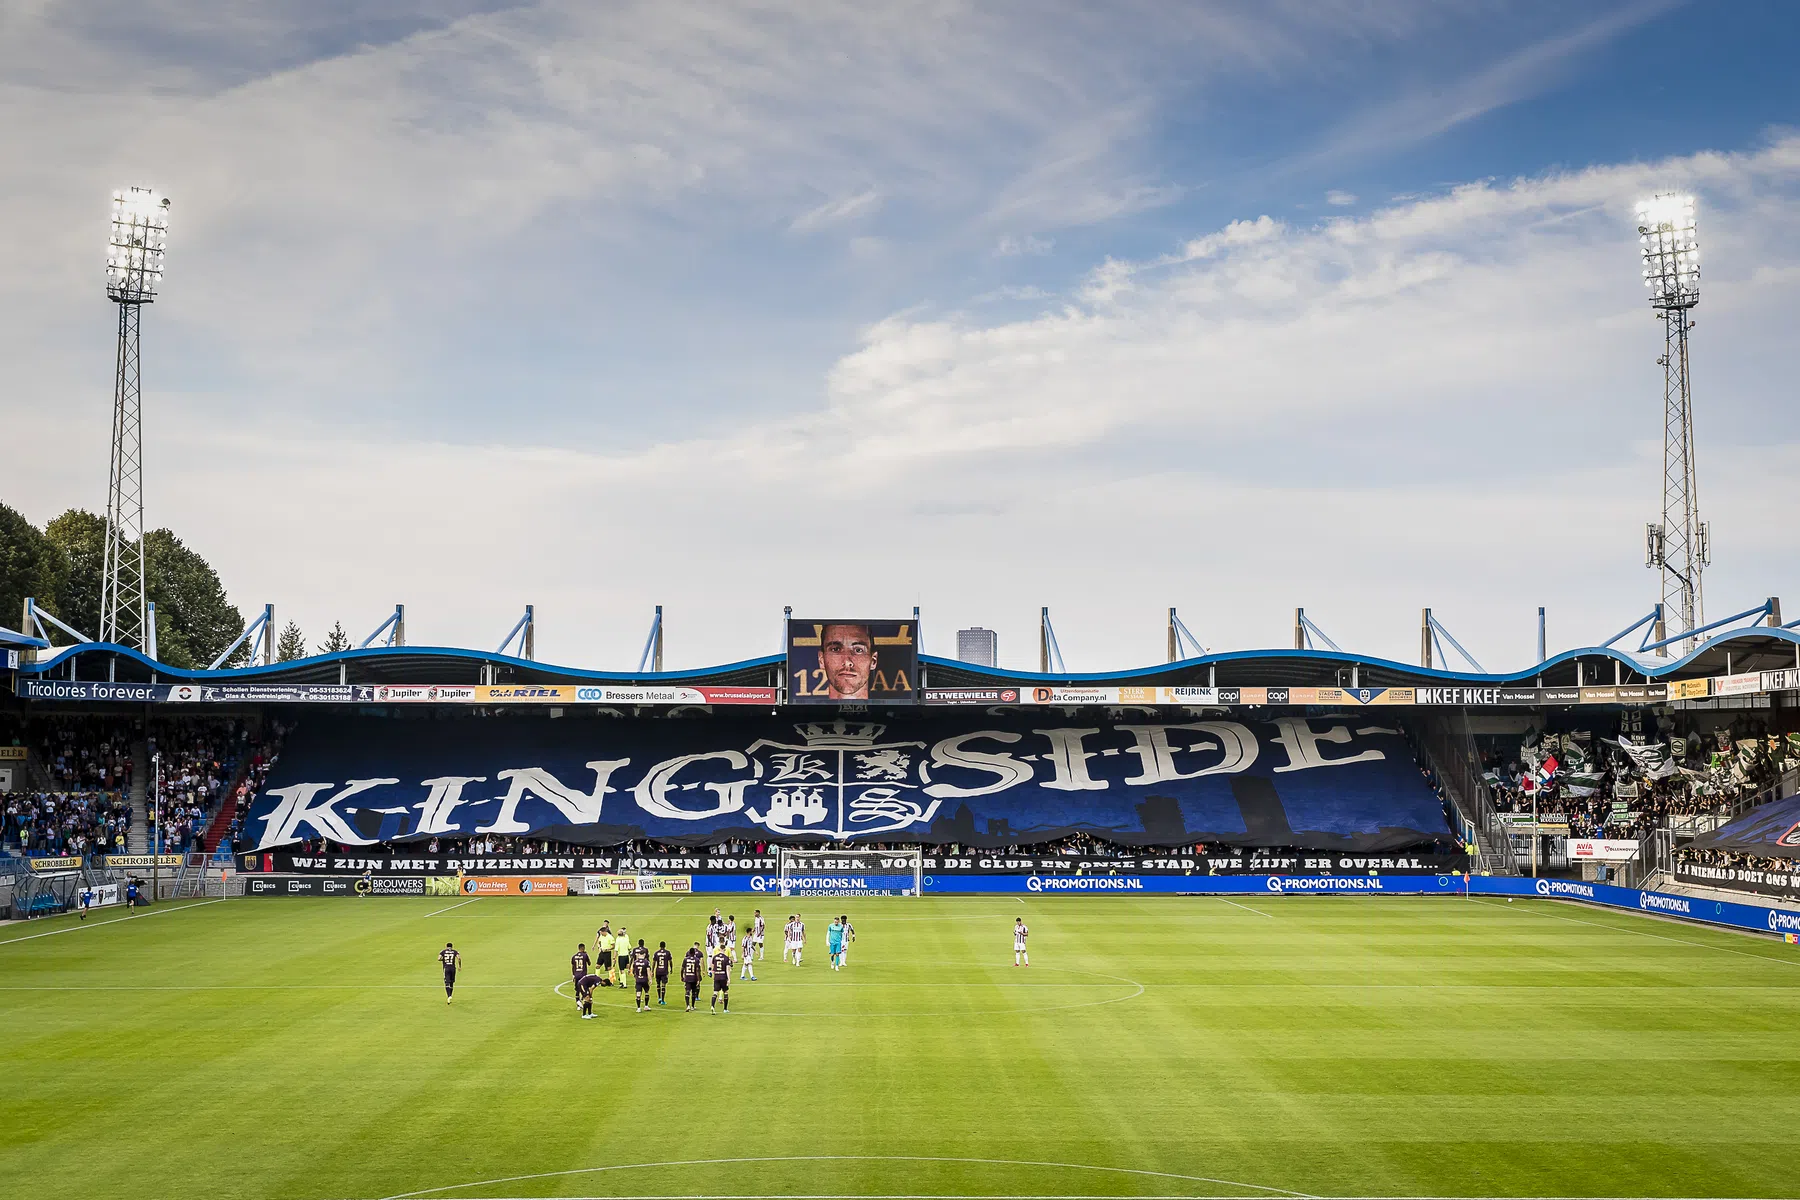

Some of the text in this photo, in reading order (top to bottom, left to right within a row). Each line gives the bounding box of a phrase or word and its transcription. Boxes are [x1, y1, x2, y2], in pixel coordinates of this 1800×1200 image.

[27, 682, 156, 699] Tricolores forever.
[794, 669, 830, 696] 12
[390, 689, 422, 698] Jupiler
[440, 689, 471, 698] Jupiler
[606, 691, 674, 700] Bressers Metaal
[922, 716, 1386, 798] SIDE
[292, 857, 327, 868] WE
[334, 858, 383, 869] ZIJN
[390, 860, 439, 870] MET
[447, 859, 574, 870] DUIZENDEN
[582, 858, 612, 868] EN
[708, 859, 776, 868] NOOIT
[881, 859, 936, 868] VOOR
[944, 859, 972, 868] DE
[979, 859, 1034, 868] CLUB
[1208, 859, 1242, 868] WE
[1305, 859, 1332, 868] ER
[750, 876, 868, 892] Q-PROMOTIONS.NL
[1026, 876, 1143, 892] Q-PROMOTIONS.NL
[1266, 876, 1383, 892] Q-PROMOTIONS.NL
[1737, 870, 1763, 883] DOET
[1766, 874, 1788, 887] ONS
[1536, 879, 1594, 897] Q-PROMOTIONS.NL
[1640, 892, 1690, 912] Q-PROMOTIONS.NL
[574, 959, 583, 968] 14
[686, 963, 695, 972] 21
